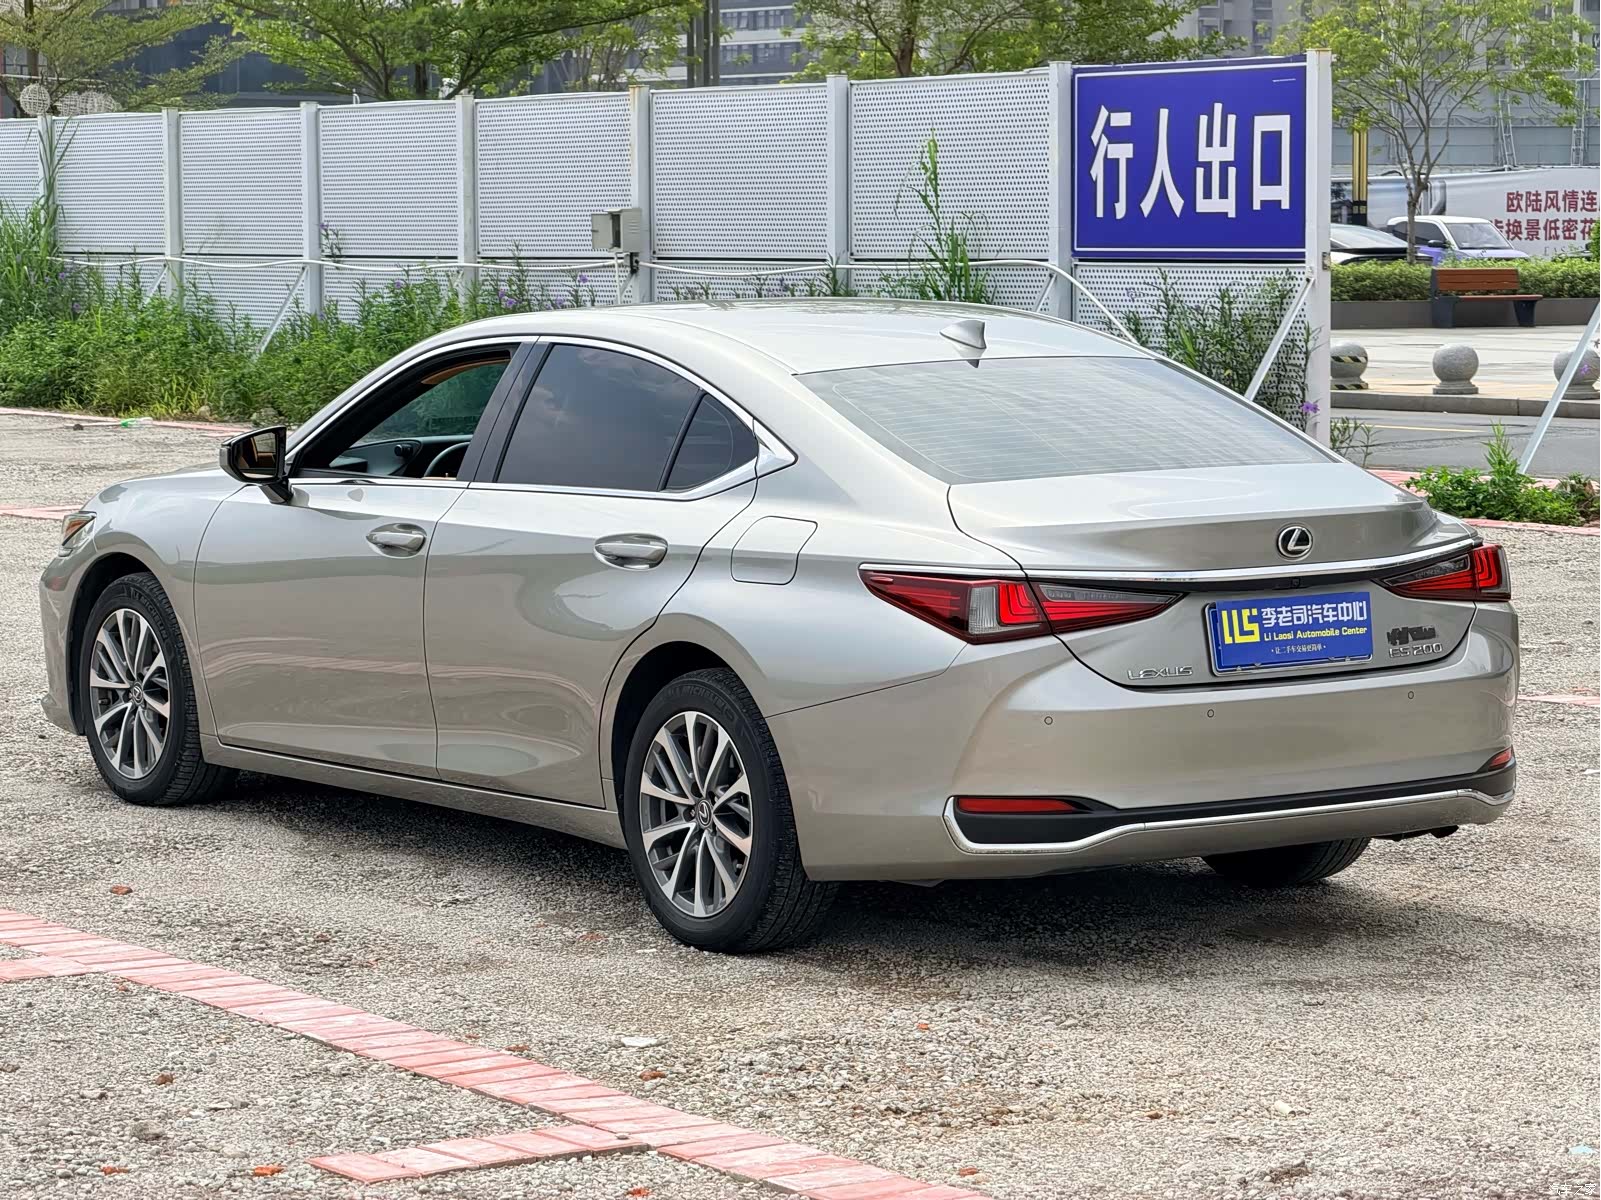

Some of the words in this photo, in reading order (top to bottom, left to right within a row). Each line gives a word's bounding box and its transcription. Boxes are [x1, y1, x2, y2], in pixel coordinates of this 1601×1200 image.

[1089, 102, 1291, 220] 行人出口
[1506, 189, 1598, 213] 欧陆风情连
[1261, 600, 1368, 628] 李老司汽车中心
[1263, 632, 1272, 642] Li
[1273, 630, 1295, 641] Laosi
[1296, 627, 1340, 639] Automobile
[1341, 626, 1368, 636] Center
[1389, 645, 1410, 658] ES
[1412, 642, 1443, 656] 200
[1127, 665, 1193, 681] LEXUS
